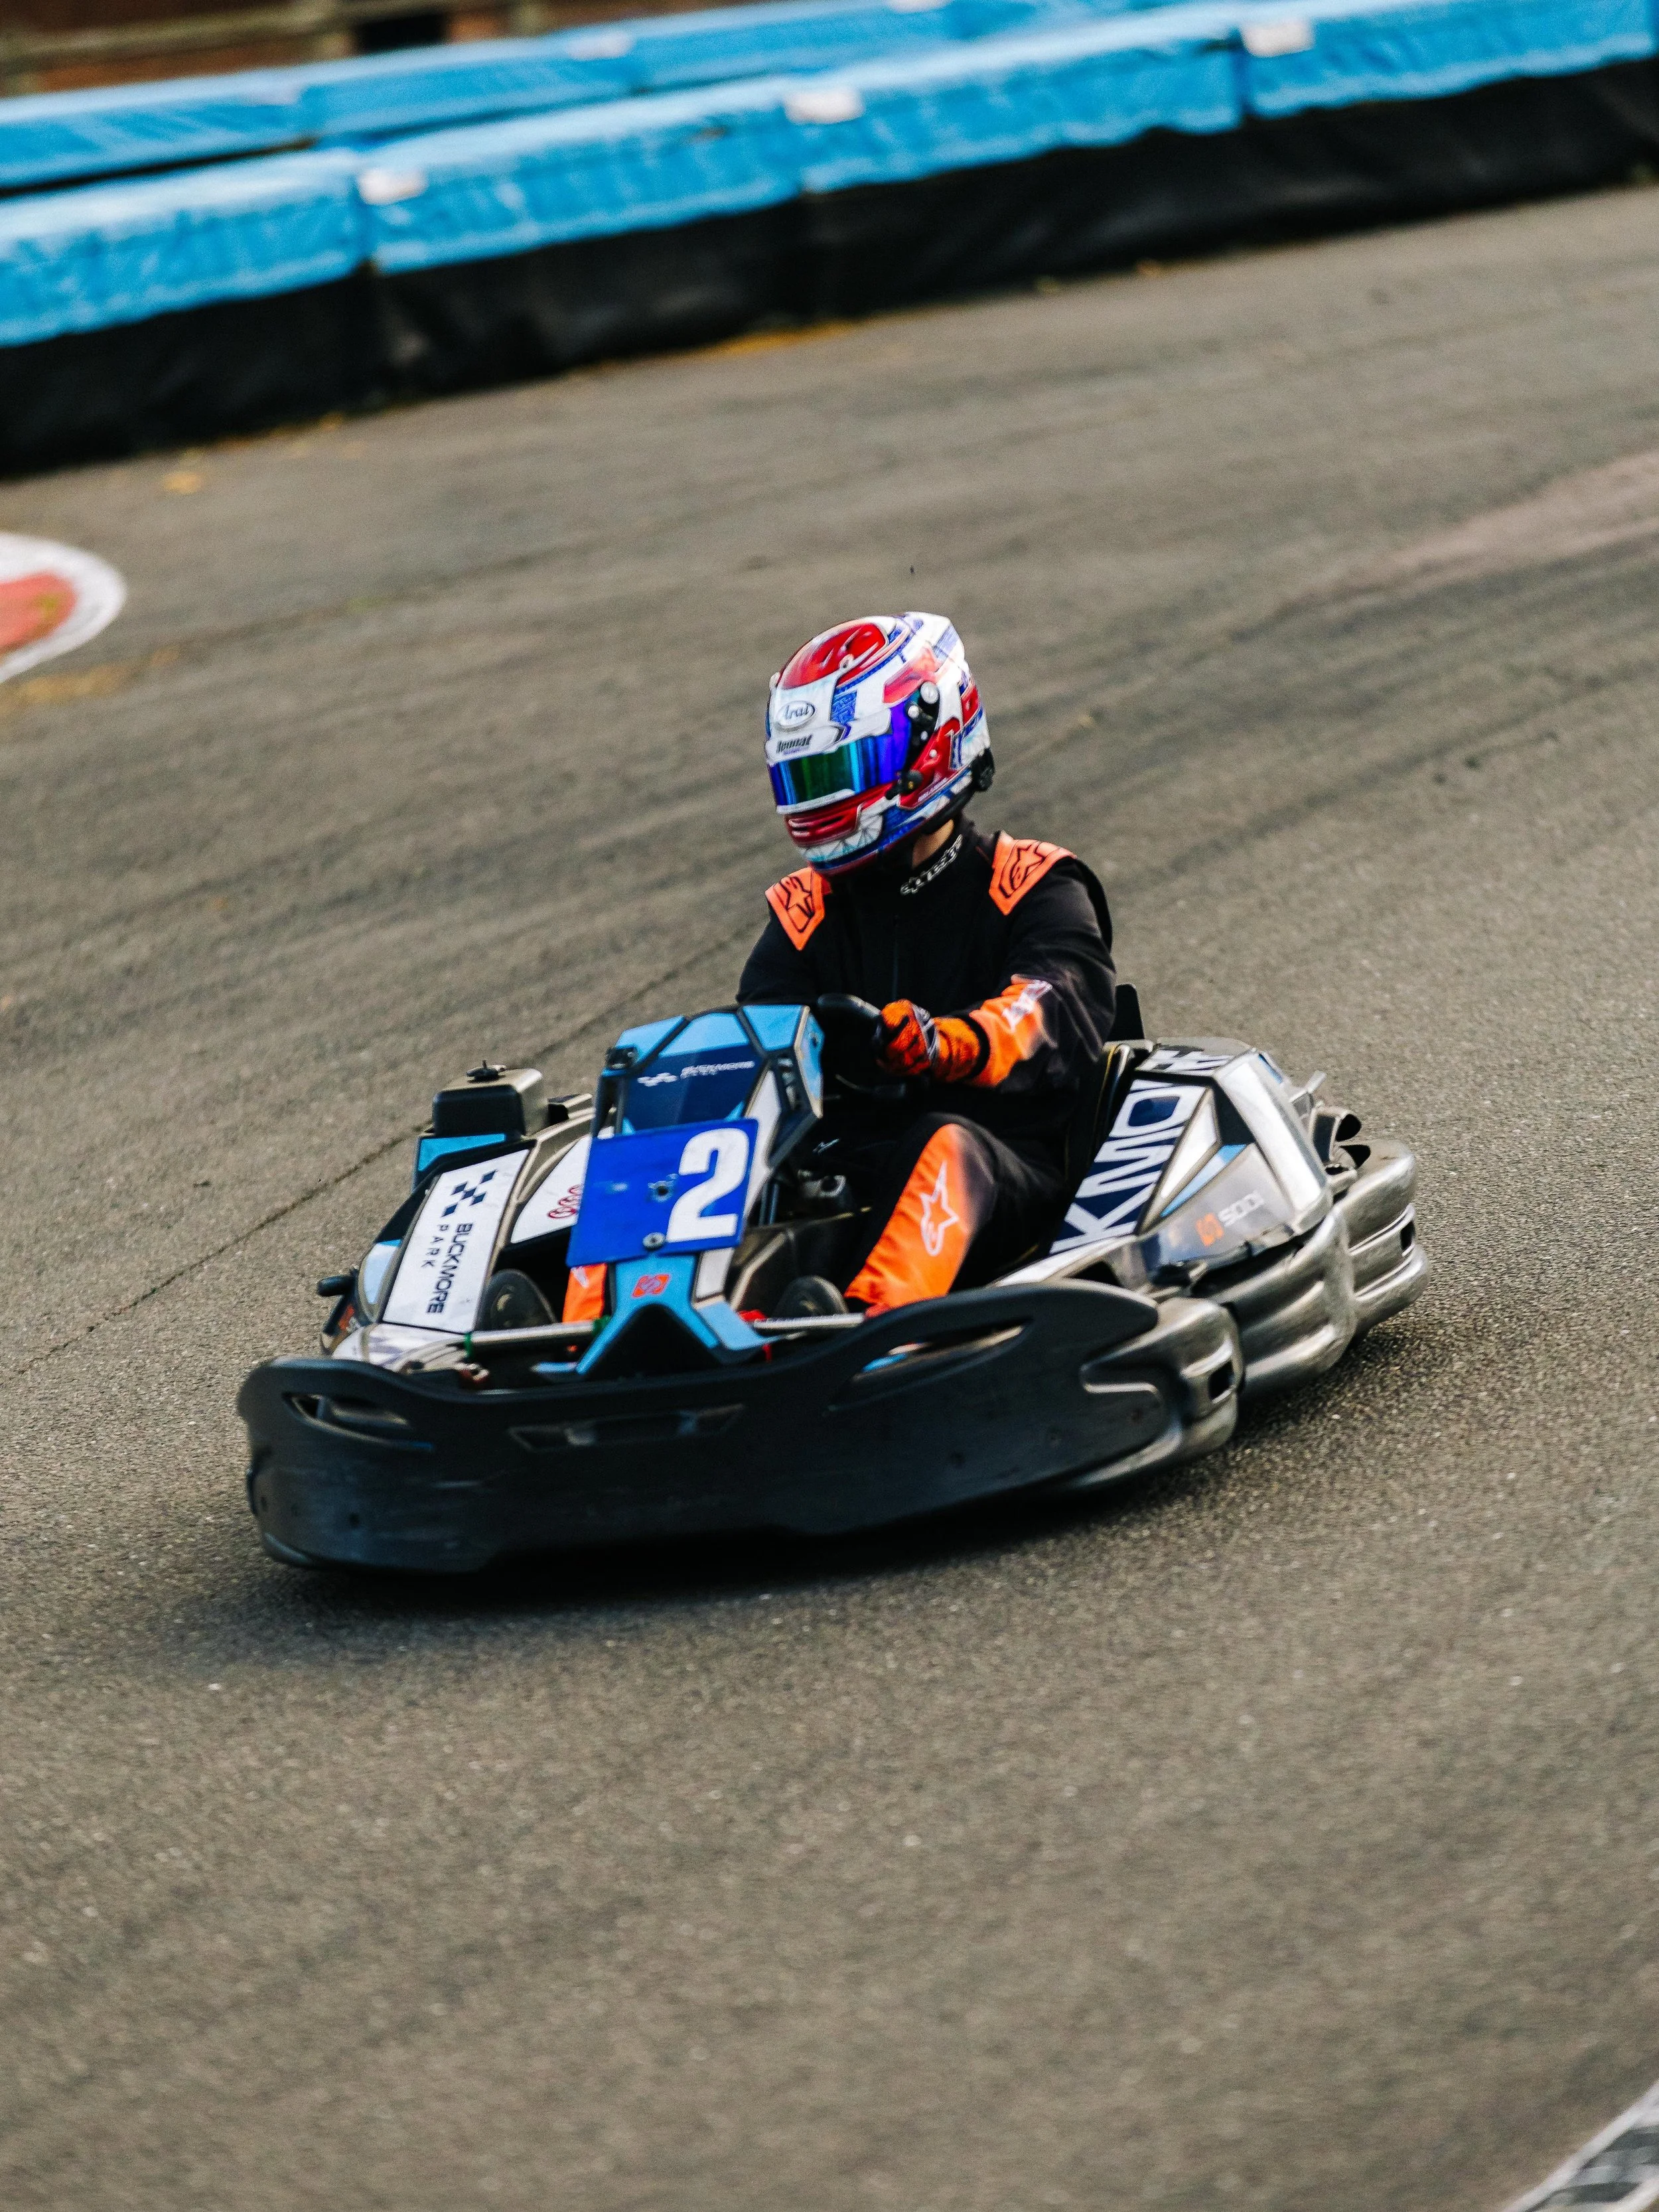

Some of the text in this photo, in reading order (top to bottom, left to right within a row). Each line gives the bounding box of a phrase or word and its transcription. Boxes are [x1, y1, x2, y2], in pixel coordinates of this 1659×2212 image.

[666, 1127, 750, 1244] 2
[420, 1223, 449, 1268] PARK
[426, 1222, 473, 1313] BUCKMORE
